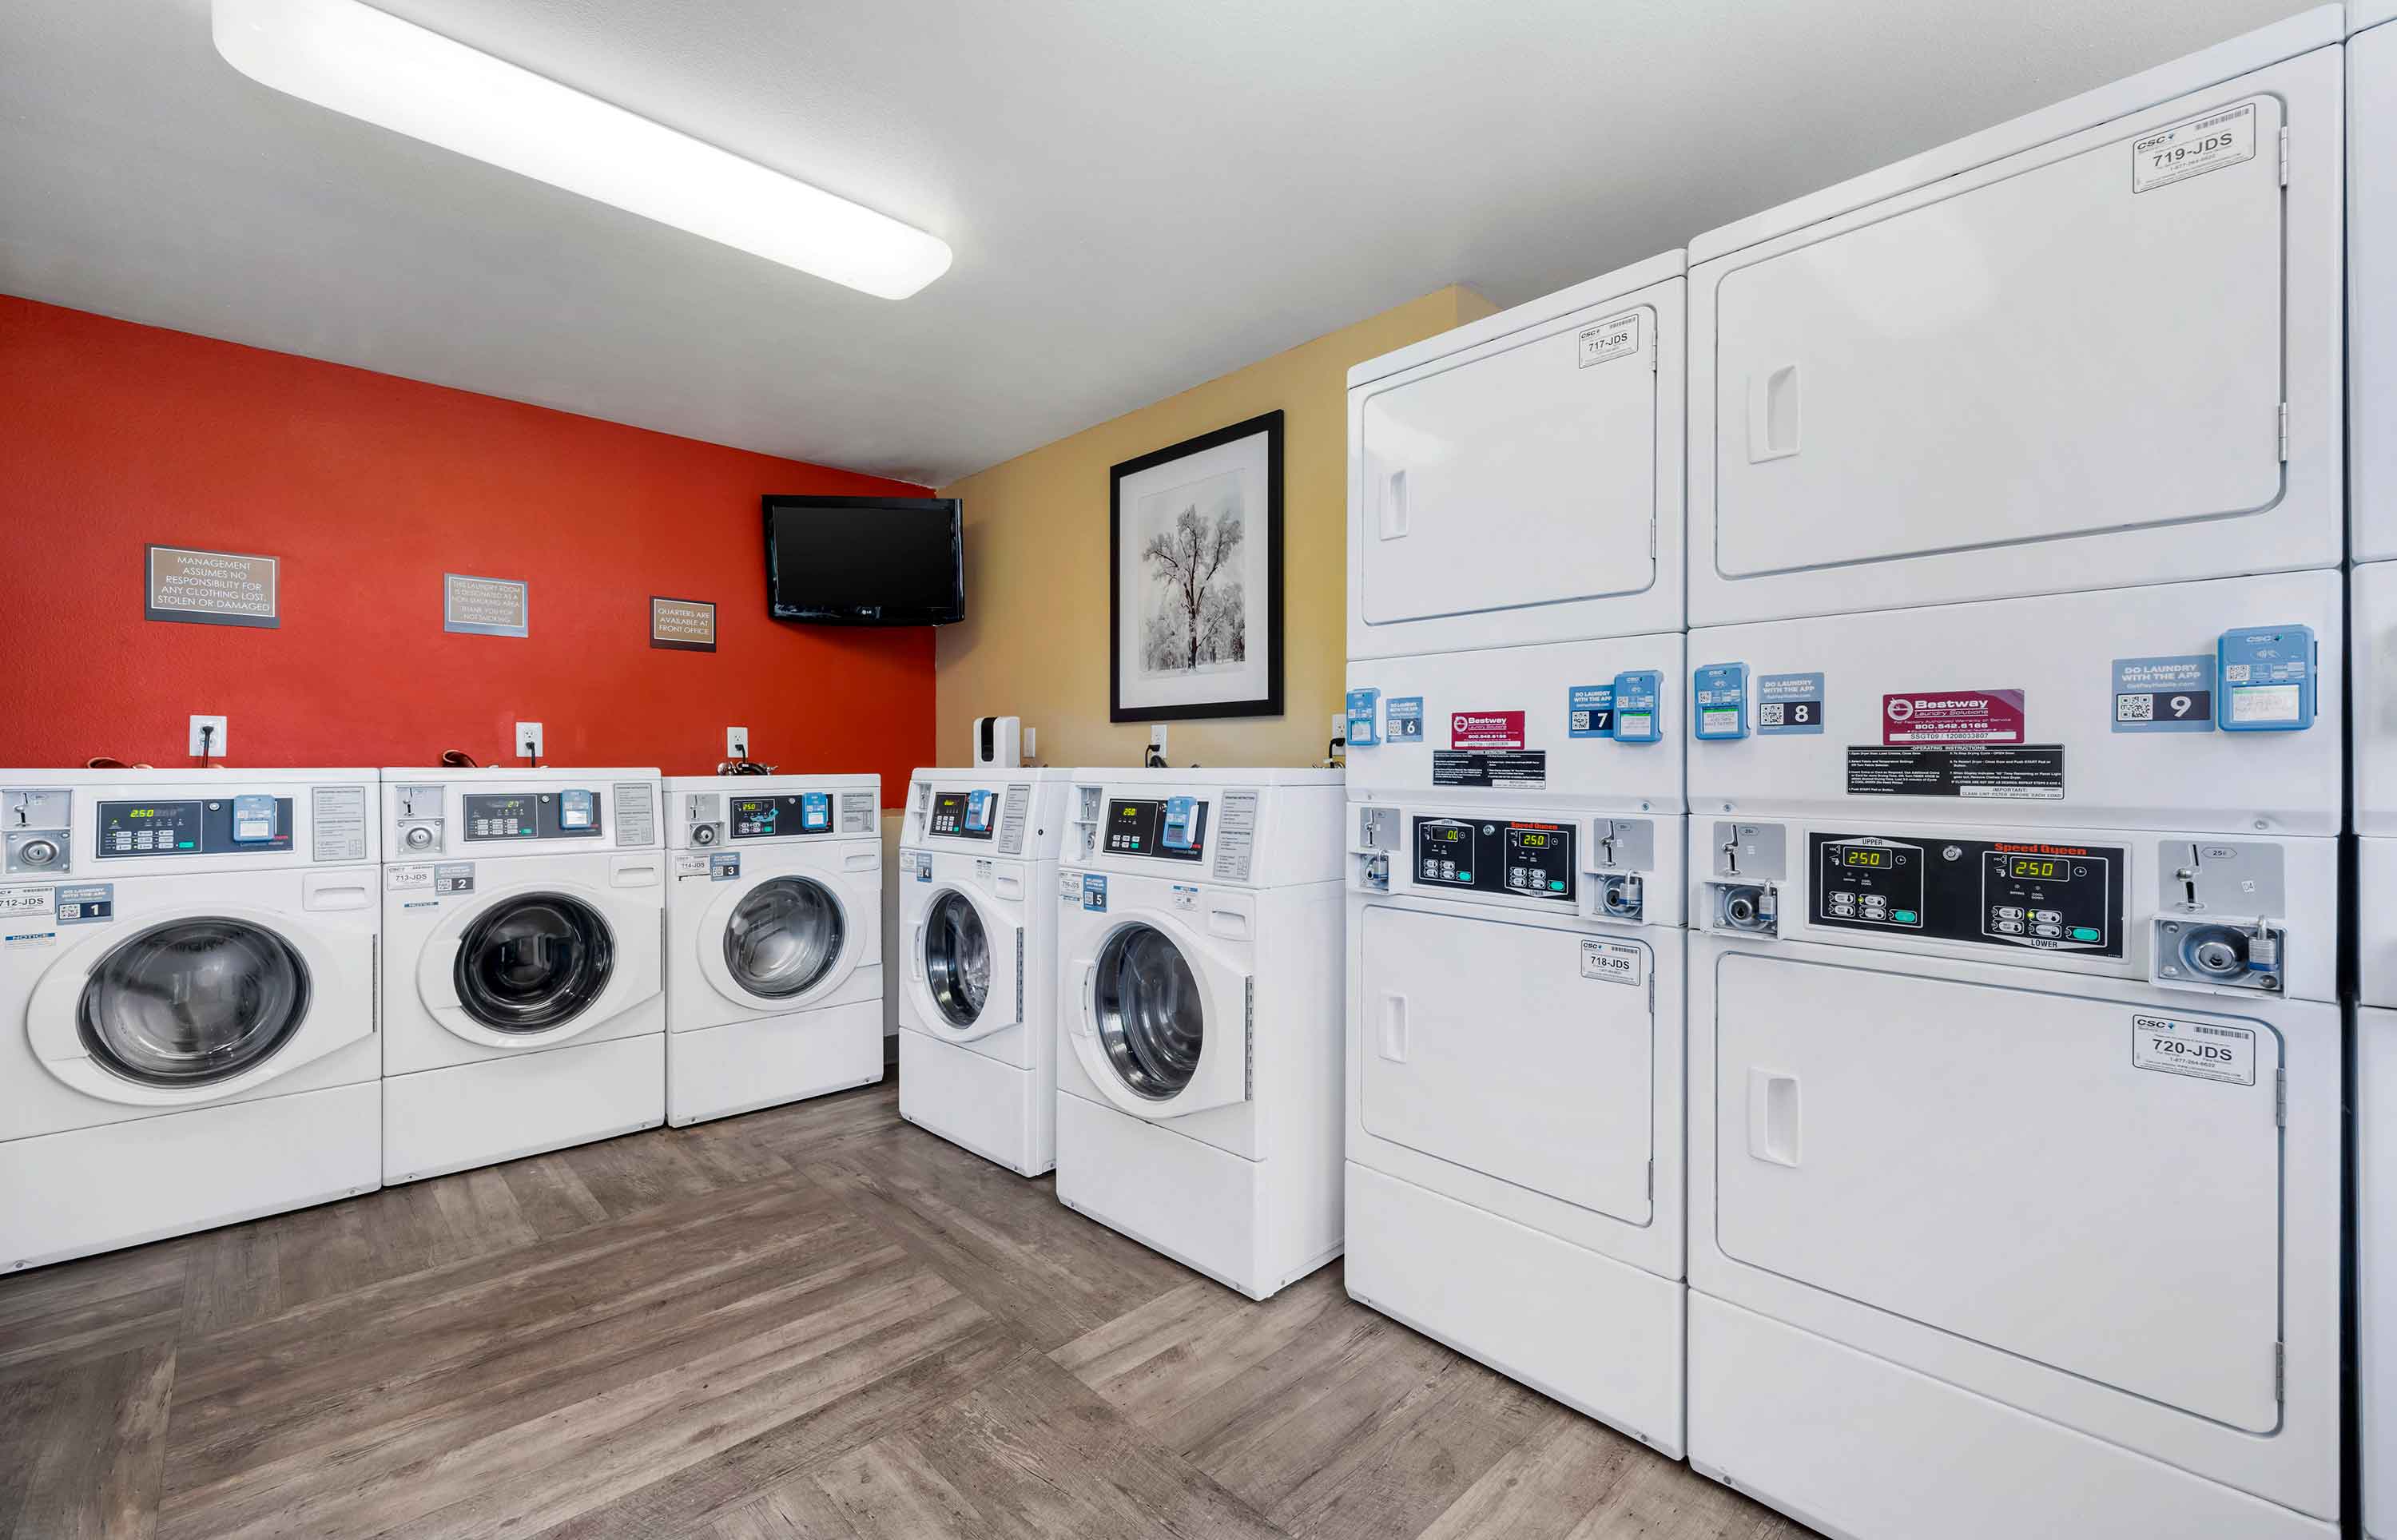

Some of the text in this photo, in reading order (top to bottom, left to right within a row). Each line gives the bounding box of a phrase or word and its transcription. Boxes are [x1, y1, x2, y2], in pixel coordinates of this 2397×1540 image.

[2137, 136, 2165, 150] CSC
[2153, 133, 2232, 167] 719-JDS
[1588, 332, 1628, 351] 717-JDS
[177, 557, 250, 570] MANAGEMENT
[182, 567, 227, 579] ASSUMES
[166, 576, 262, 591] RESPONSIBILITY FOR
[186, 587, 239, 599] CLOTHING
[157, 595, 270, 612] STOLEN OR DAMAGED
[658, 608, 694, 617] QUARTERS
[660, 617, 698, 626] AVAILABLE
[683, 626, 710, 635] OFFICE
[2143, 664, 2197, 673] LAUNDRY
[1914, 700, 1989, 709] Bestway
[2170, 696, 2192, 717] 9
[1597, 712, 1608, 728] 7
[1795, 705, 1809, 723] 8
[1407, 720, 1415, 734] 6
[1524, 835, 1544, 845] 250
[1994, 843, 2087, 855] Speed Queen
[1848, 851, 1880, 865] 250
[2015, 861, 2053, 876] 250
[458, 879, 467, 888] 2
[1096, 895, 1103, 905] 5
[91, 904, 99, 915] 1
[2030, 939, 2058, 948] LOWER
[1591, 956, 1630, 970] 718-JDS
[2137, 1019, 2166, 1029] CSC
[2152, 1038, 2232, 1061] 720-JDS
